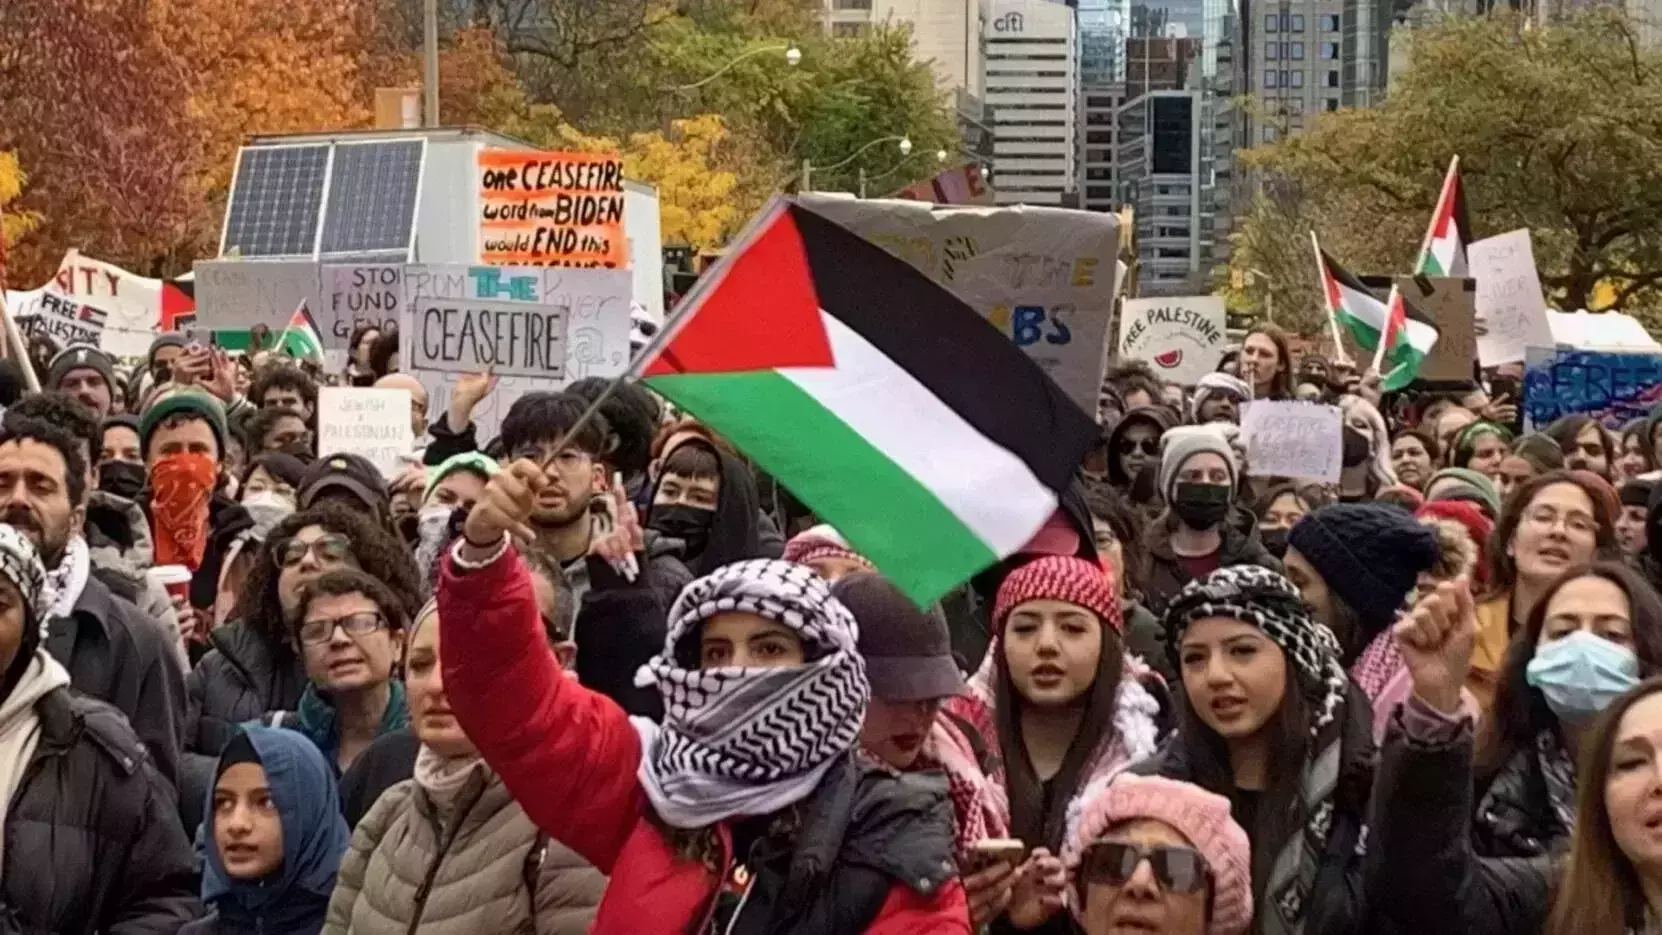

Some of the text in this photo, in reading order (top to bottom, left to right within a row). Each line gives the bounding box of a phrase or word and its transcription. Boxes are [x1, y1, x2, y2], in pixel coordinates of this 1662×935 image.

[994, 12, 1023, 32] citi
[483, 160, 624, 192] one CEASEFIRE
[483, 200, 528, 221] word
[554, 194, 625, 226] BIDEN
[484, 227, 610, 257] would END this
[352, 267, 400, 287] STO
[468, 267, 539, 300] THE
[41, 292, 78, 320] FREE
[423, 307, 560, 372] CEASEFIRE
[1121, 306, 1222, 355] FREE PALESTINE
